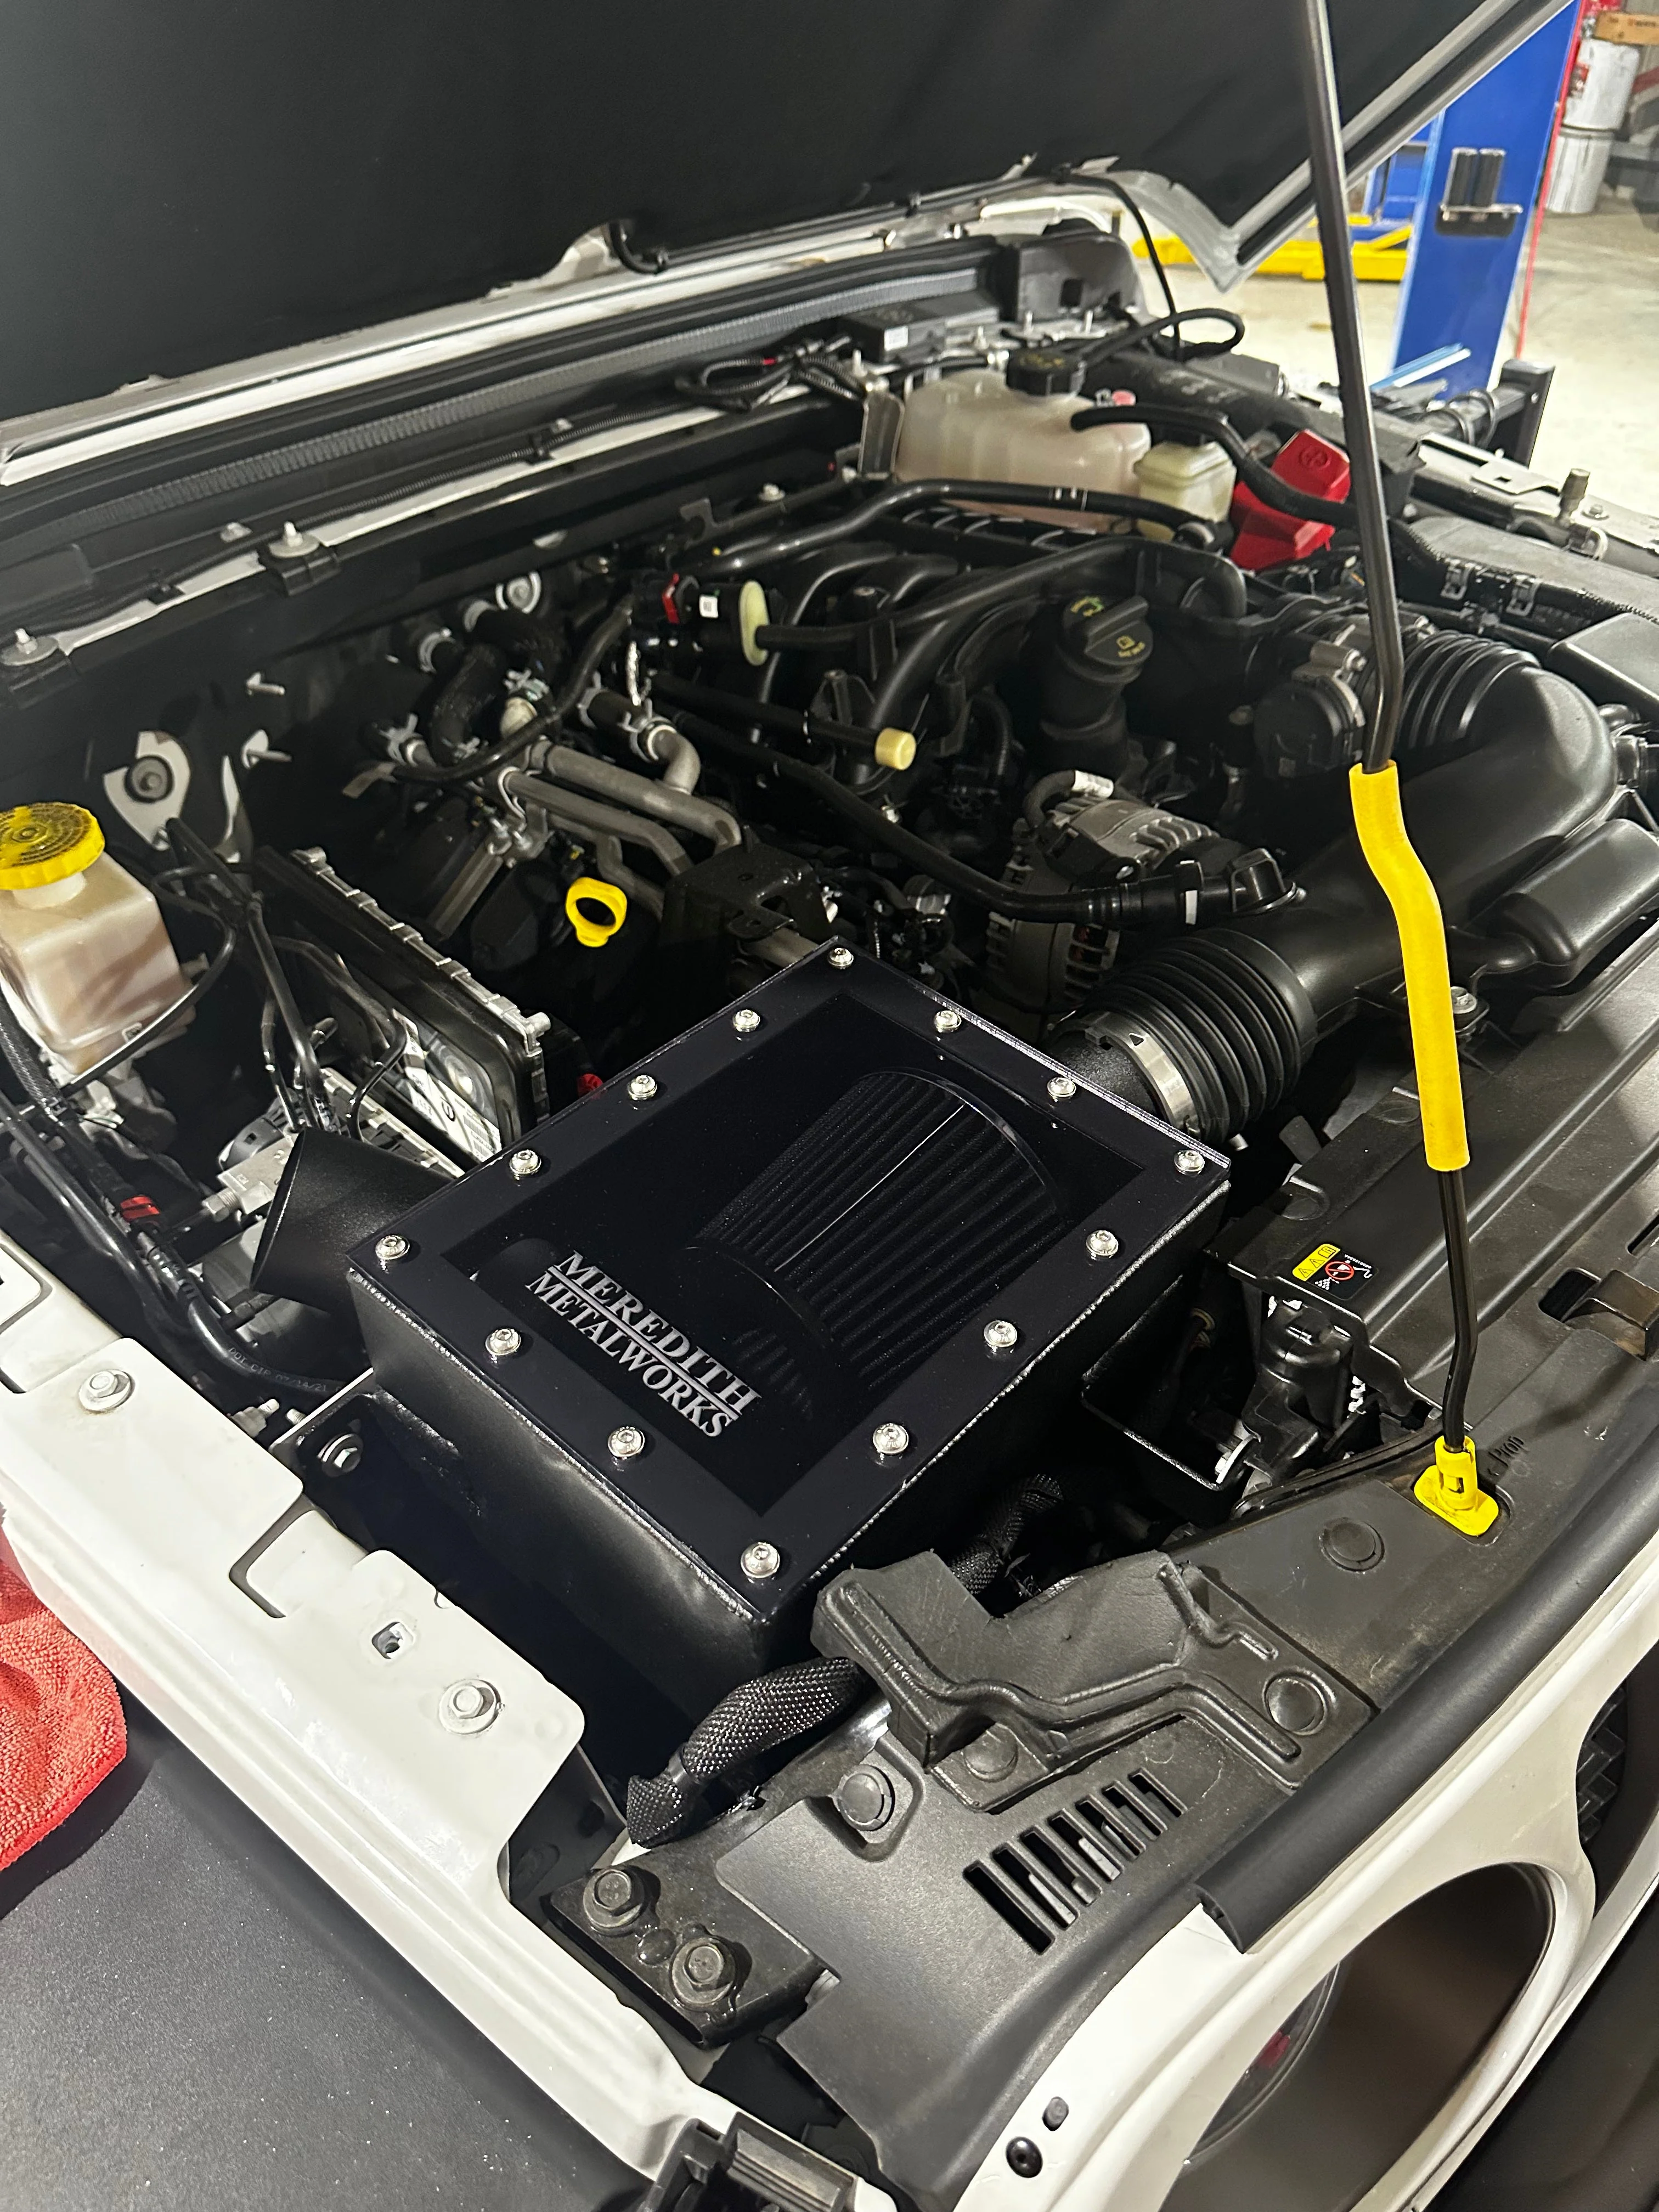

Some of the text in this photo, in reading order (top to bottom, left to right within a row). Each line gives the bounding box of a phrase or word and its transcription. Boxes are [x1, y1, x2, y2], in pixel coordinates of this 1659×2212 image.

[228, 1347, 247, 1364] DOT
[524, 1271, 734, 1437] METALWORKS
[555, 1250, 763, 1415] MEREDITH
[1487, 1435, 1530, 1467] Prop
